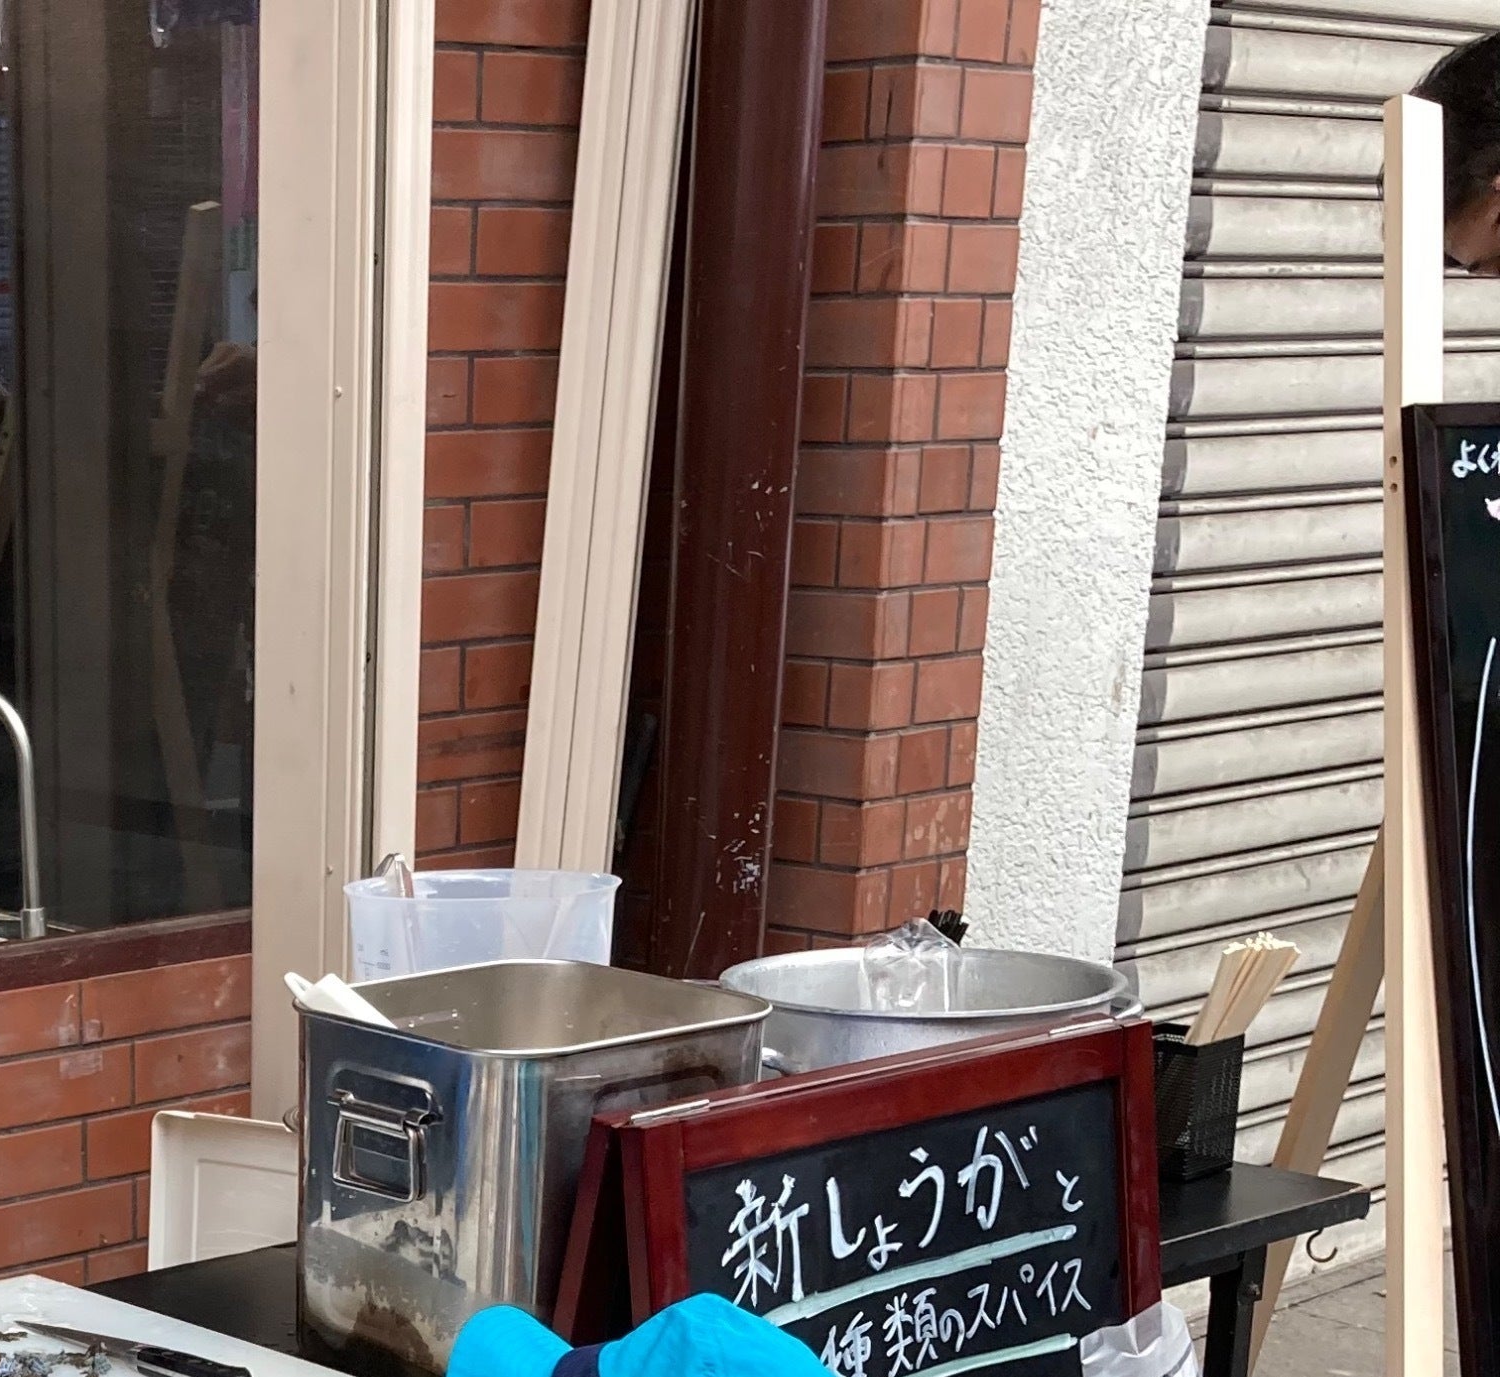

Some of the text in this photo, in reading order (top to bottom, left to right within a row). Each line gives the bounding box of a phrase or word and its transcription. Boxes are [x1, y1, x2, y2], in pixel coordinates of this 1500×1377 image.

[721, 1125, 1083, 1304] 新しょうがと
